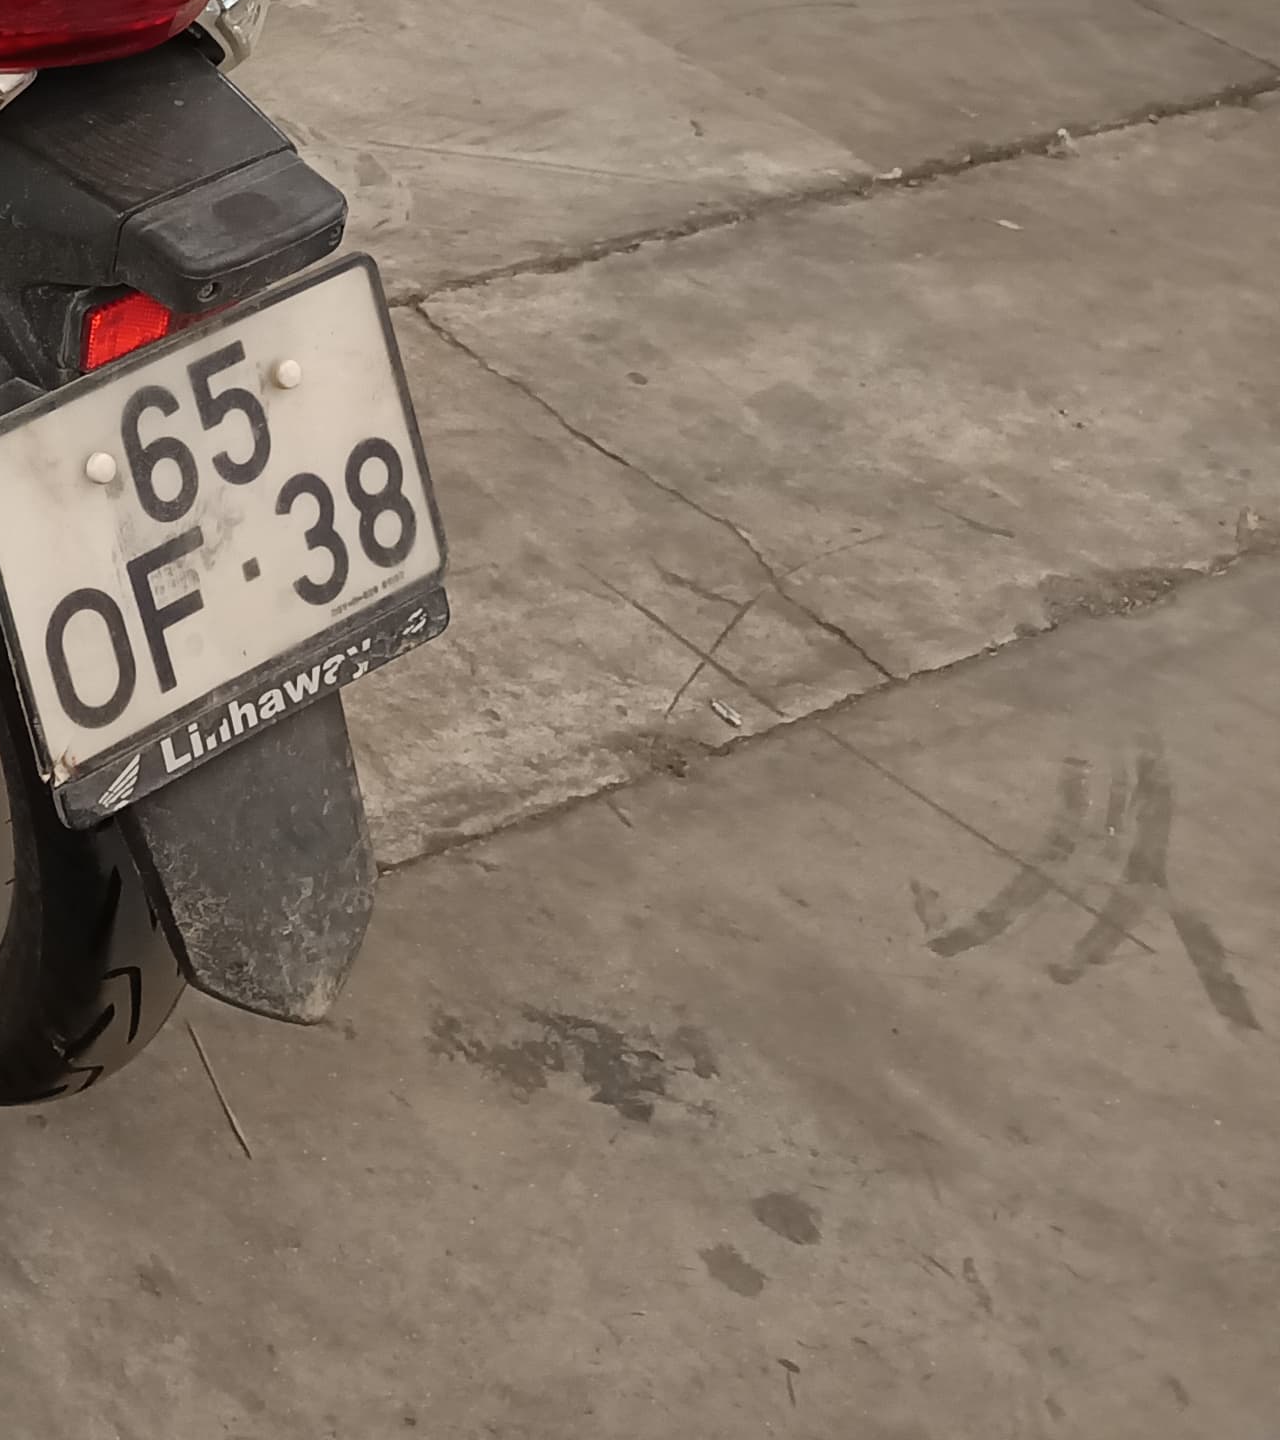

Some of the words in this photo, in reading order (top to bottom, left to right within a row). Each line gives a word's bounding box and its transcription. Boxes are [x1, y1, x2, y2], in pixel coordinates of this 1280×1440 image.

[121, 340, 271, 522] 65
[45, 526, 204, 729] OF
[275, 437, 416, 605] 38
